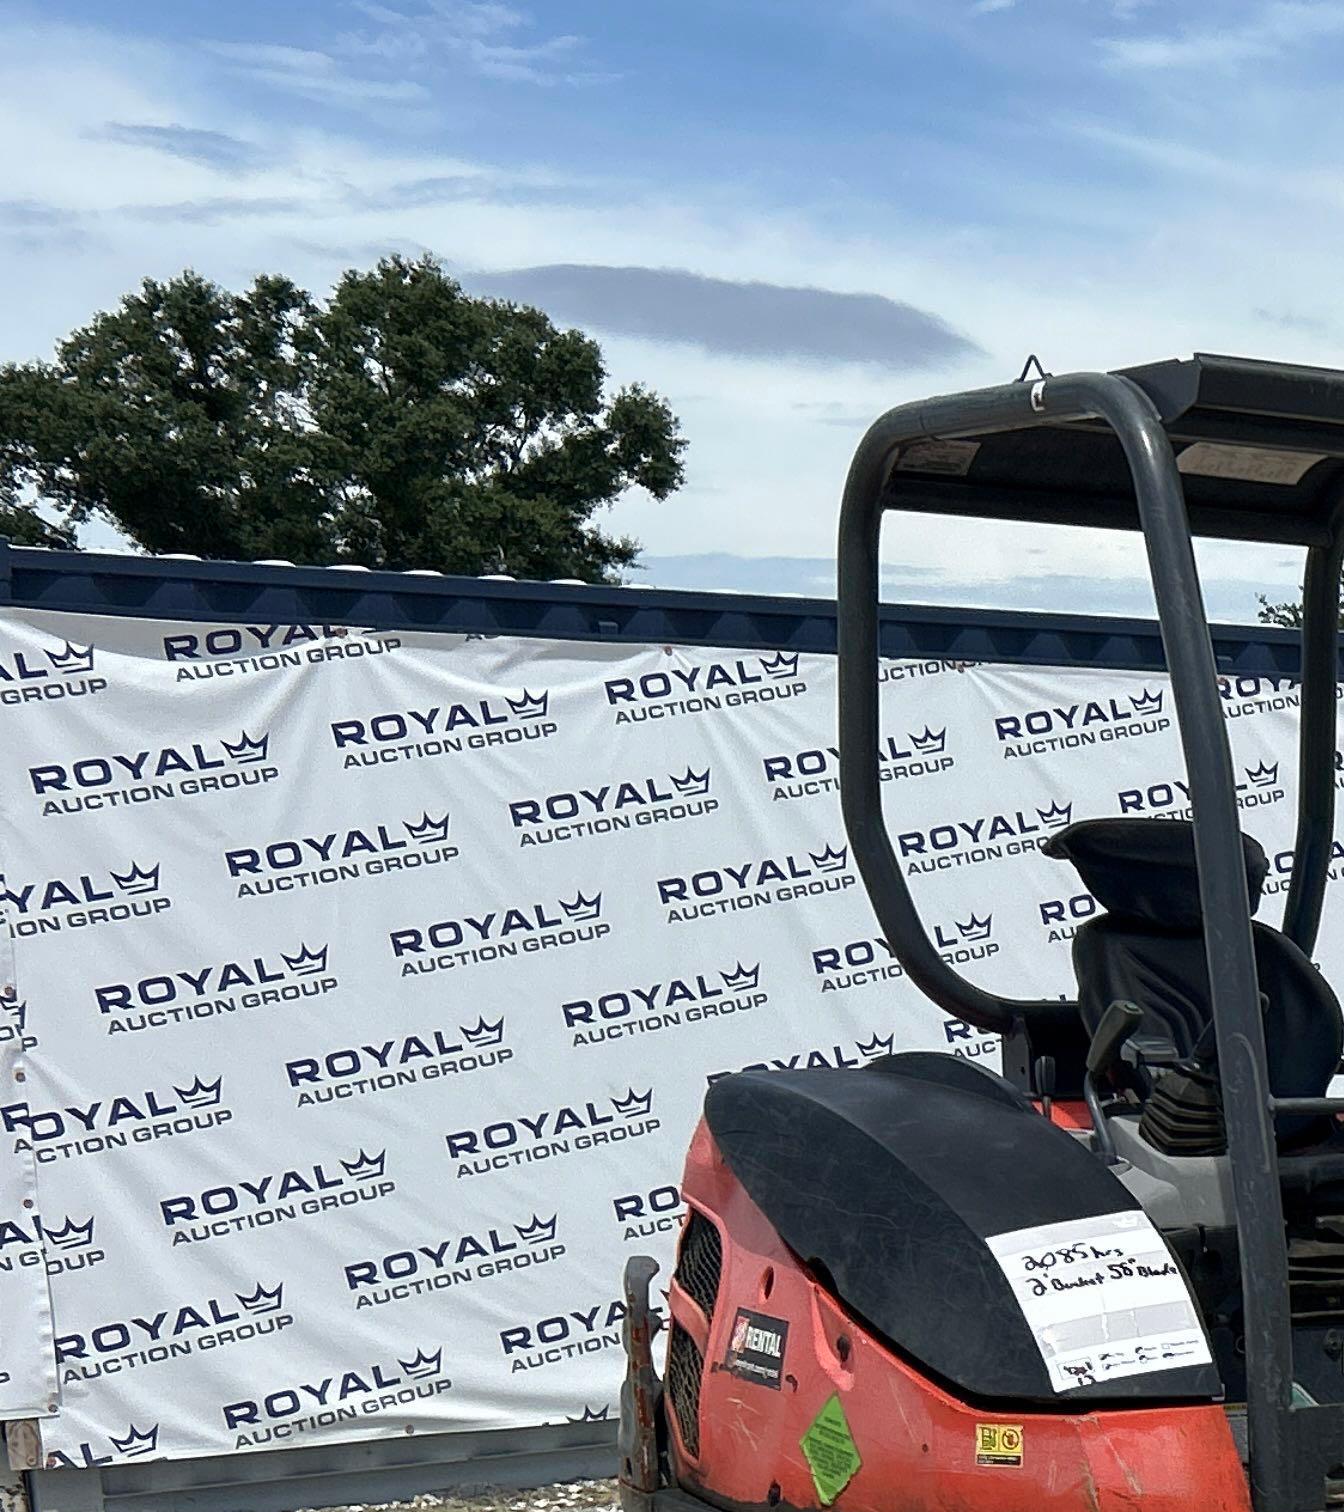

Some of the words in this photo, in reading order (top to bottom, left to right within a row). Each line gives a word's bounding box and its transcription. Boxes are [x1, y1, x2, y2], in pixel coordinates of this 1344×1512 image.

[175, 652, 301, 682] AUCTION
[307, 638, 401, 667] GROUP
[603, 657, 762, 704] ROYAL
[1, 678, 106, 706] GROUP
[615, 695, 721, 724] AUCTION
[725, 682, 806, 706] GROUP
[994, 695, 1132, 740] ROYAL
[331, 696, 508, 748] ROYAL
[343, 737, 462, 768] AUCTION
[467, 722, 557, 748] GROUP
[1004, 731, 1095, 759] AUCTION
[1099, 718, 1169, 741] GROUP
[29, 740, 225, 794] ROYAL
[43, 782, 174, 816] AUCTION
[179, 767, 278, 794] GROUP
[877, 756, 954, 782] GROUP
[508, 774, 673, 827] ROYAL
[520, 814, 630, 847] AUCTION
[634, 799, 718, 825] GROUP
[224, 821, 407, 877] ROYAL
[898, 808, 1041, 856] ROYAL
[237, 863, 359, 898] AUCTION
[364, 846, 458, 874] GROUP
[656, 851, 812, 904] ROYAL
[908, 847, 1003, 876] AUCTION
[67, 897, 171, 928] GROUP
[667, 891, 771, 923] AUCTION
[775, 874, 855, 901] GROUP
[389, 900, 562, 956] ROYAL
[401, 941, 517, 977] AUCTION
[522, 923, 610, 952] GROUP
[94, 953, 285, 1013] ROYAL
[108, 997, 235, 1035] AUCTION
[241, 977, 337, 1008] GROUP
[561, 971, 723, 1027] ROYAL
[573, 1011, 680, 1046] AUCTION
[685, 993, 767, 1021] GROUP
[285, 1026, 463, 1087] ROYAL
[297, 1069, 416, 1107] AUCTION
[421, 1048, 512, 1079] GROUP
[133, 1110, 232, 1142] GROUP
[445, 1097, 614, 1158] ROYAL
[457, 1139, 569, 1178] AUCTION
[574, 1118, 660, 1149] GROUP
[159, 1159, 344, 1225] ROYAL
[173, 1204, 296, 1246] AUCTION
[301, 1181, 394, 1214] GROUP
[343, 1224, 517, 1289] ROYAL
[356, 1268, 472, 1309] AUCTION
[476, 1244, 565, 1277] GROUP
[54, 1293, 240, 1364] ROYAL
[63, 1340, 190, 1384] AUCTION
[196, 1314, 293, 1349] GROUP
[512, 1332, 621, 1372] AUCTION
[745, 1325, 782, 1359] RENTAL
[223, 1359, 401, 1429] ROYAL
[237, 1404, 356, 1449] AUCTION
[360, 1378, 451, 1413] GROUP
